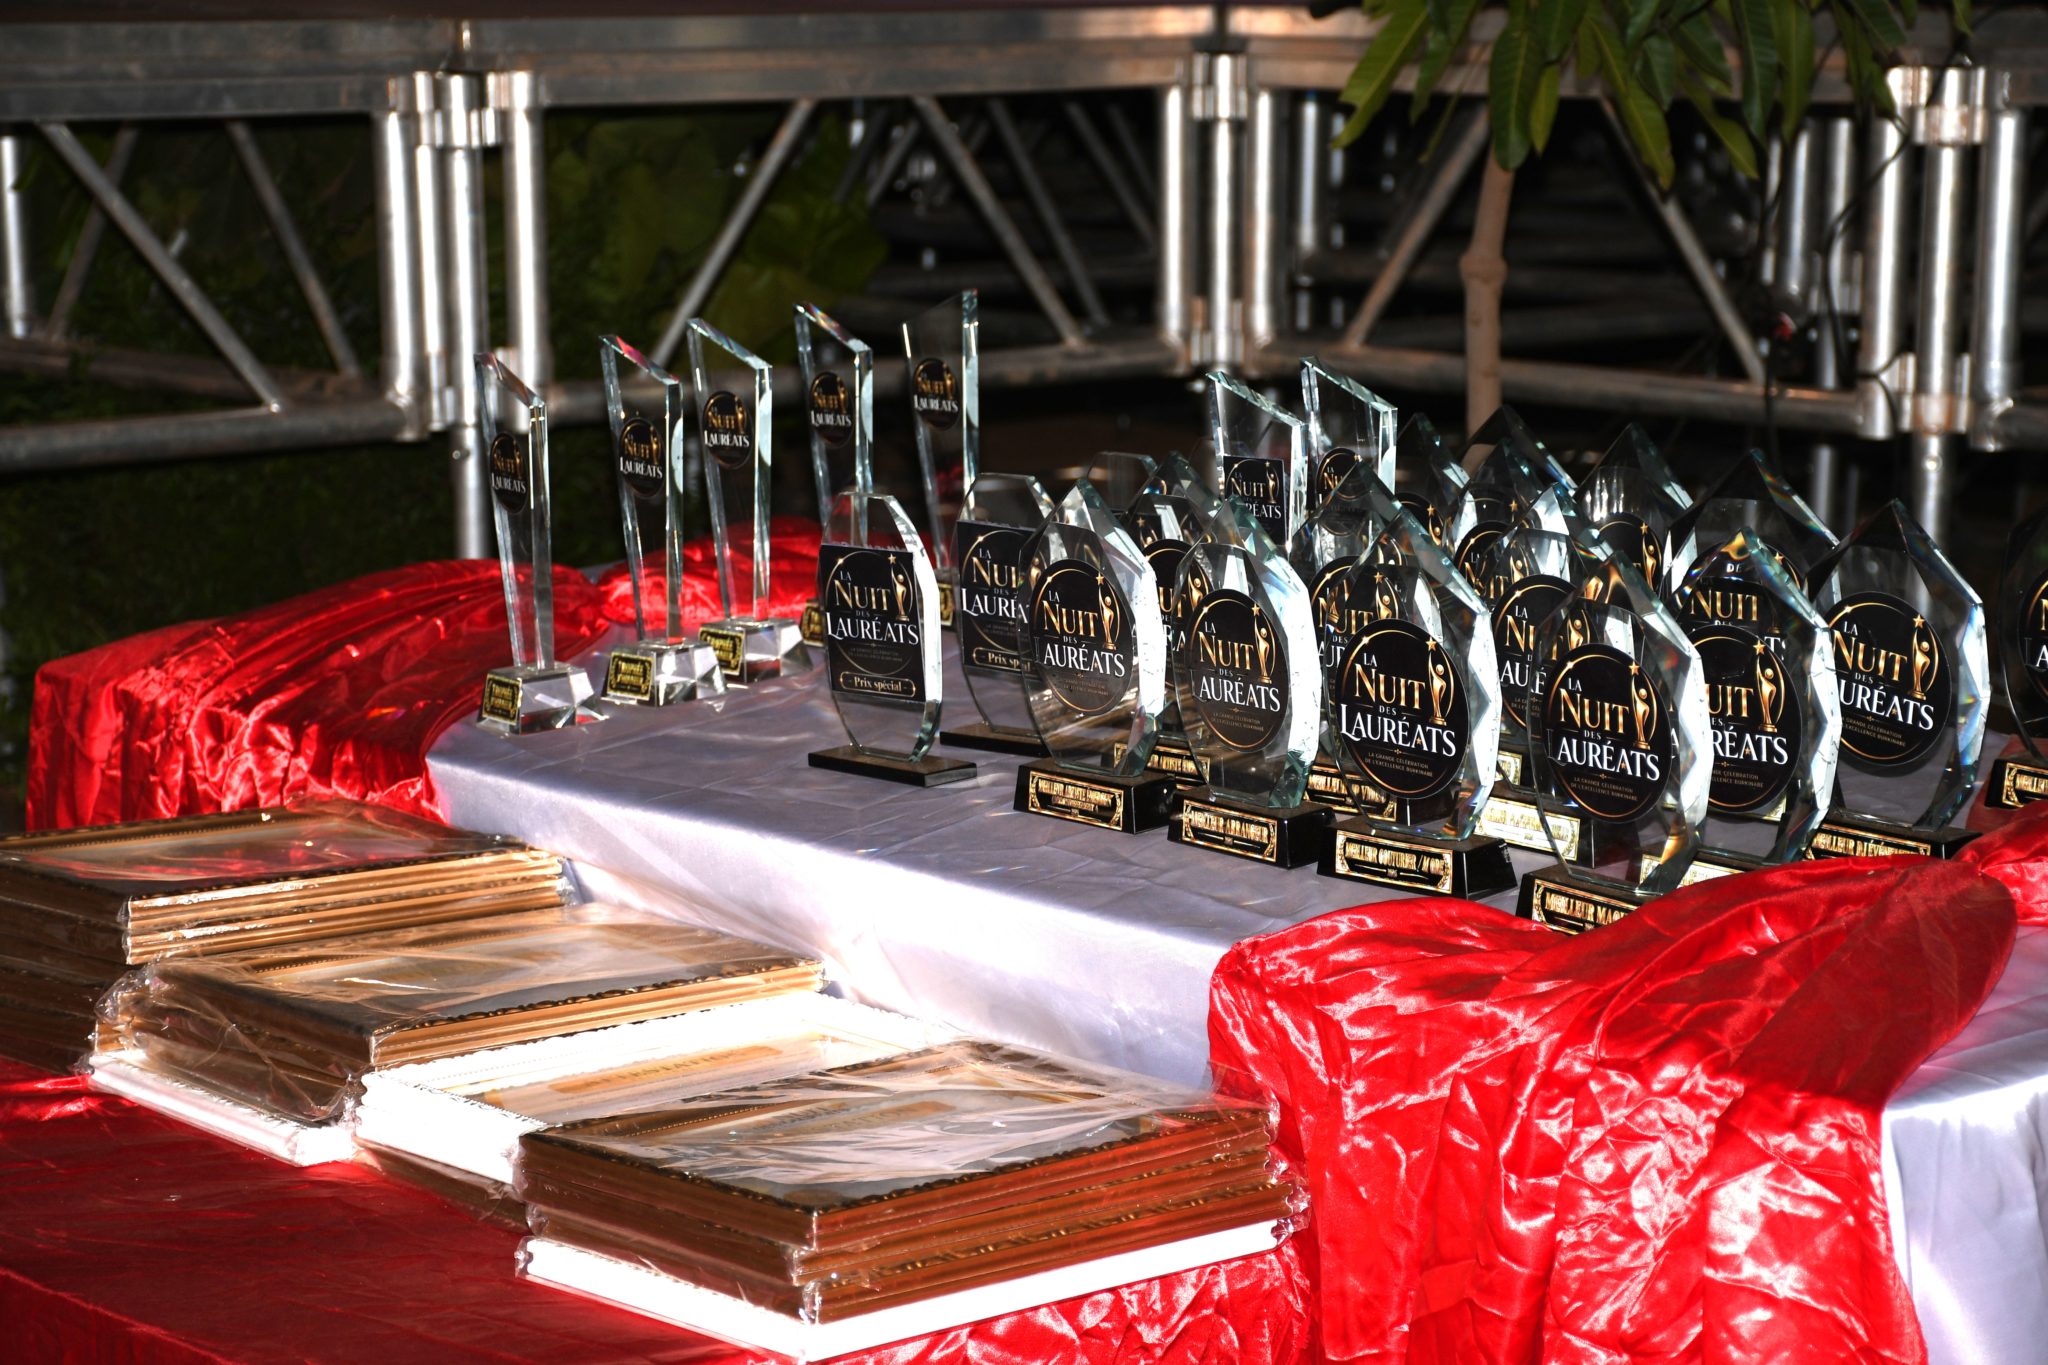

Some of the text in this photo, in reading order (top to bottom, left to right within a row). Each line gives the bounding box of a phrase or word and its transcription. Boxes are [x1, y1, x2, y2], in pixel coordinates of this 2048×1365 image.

[704, 430, 750, 448] LAURÉATS
[619, 456, 663, 479] LAURÉATS
[1230, 477, 1266, 497] NUIT
[979, 548, 992, 559] LA
[840, 570, 852, 581] LA
[972, 556, 1018, 588] NUI
[834, 579, 891, 611] NUIT
[1048, 590, 1060, 602] LA
[855, 610, 870, 618] DES
[1042, 600, 1098, 637] NUIT
[1515, 605, 1528, 619] LA
[826, 612, 919, 646] LAURÉATS
[1204, 621, 1216, 634] LA
[1844, 621, 1858, 636] LA
[1063, 635, 1078, 644] DES
[988, 652, 1007, 665] Prix
[1198, 631, 1254, 670] NUIT
[1832, 630, 1908, 682] NUIT
[1363, 652, 1378, 668] LA
[1219, 669, 1234, 678] DES
[1855, 673, 1874, 684] DES
[854, 676, 902, 692] Prix spécial
[1355, 663, 1426, 710] NUIT
[1568, 677, 1582, 692] LA
[1704, 683, 1755, 718] UIT
[1840, 681, 1935, 731] URÉATS
[1379, 705, 1397, 716] DES
[1558, 687, 1631, 734] NUIT
[1340, 703, 1457, 757] LAURÉATS
[1583, 730, 1602, 740] DES
[1711, 726, 1789, 766] RÉATS
[1545, 892, 1594, 920] MEILLEUR
